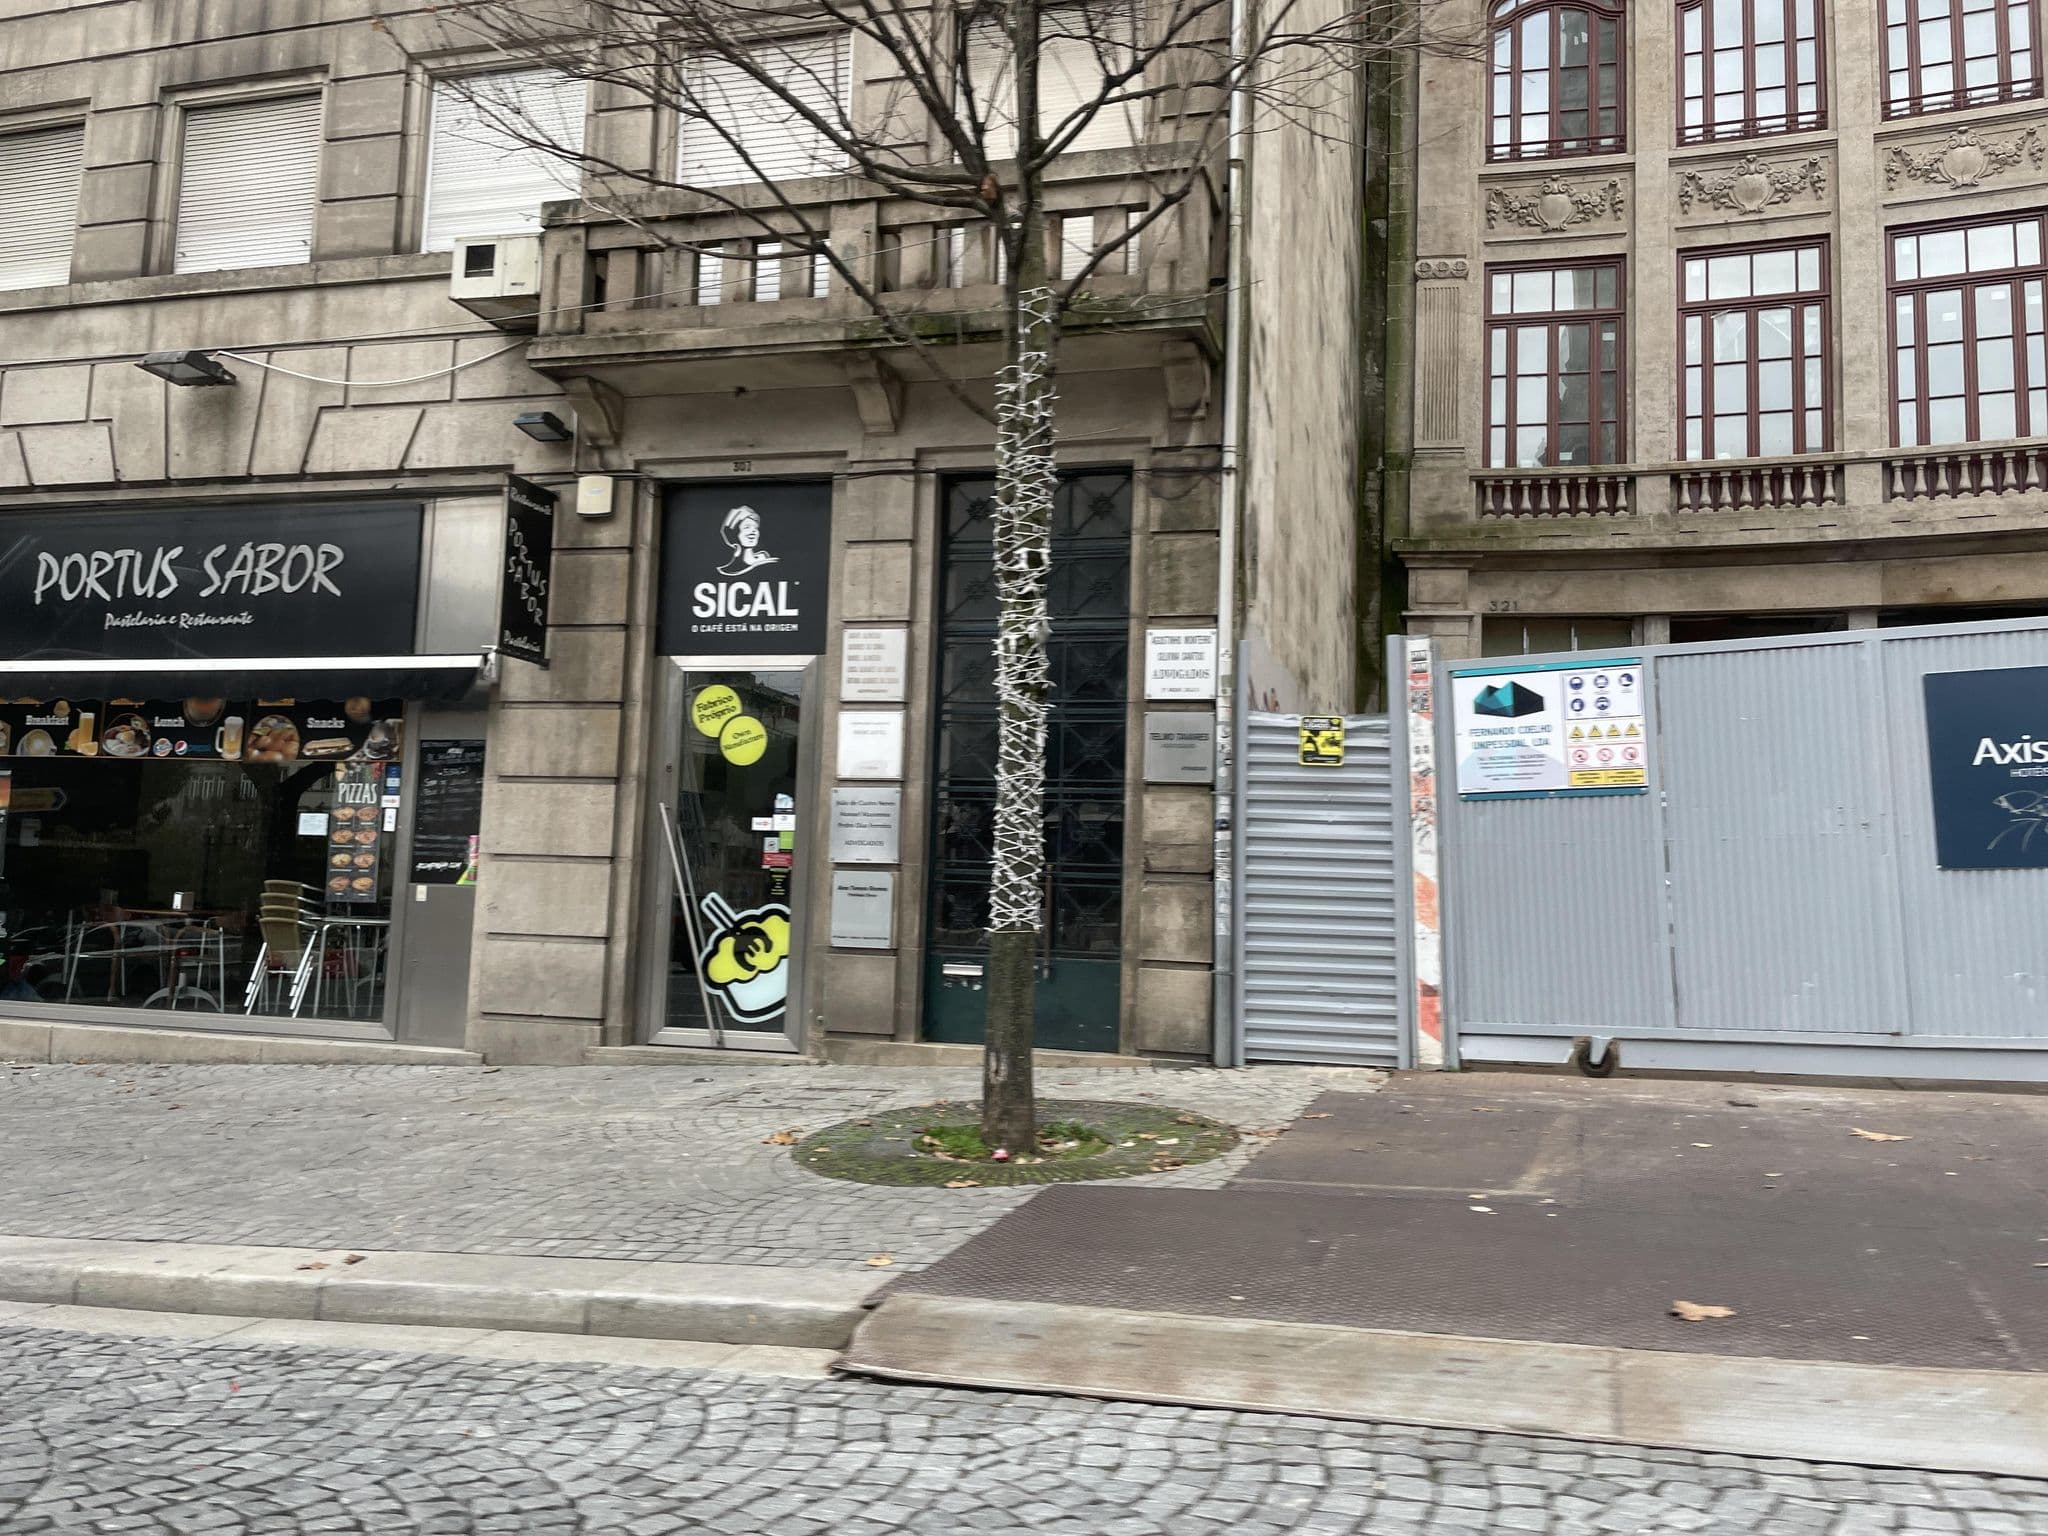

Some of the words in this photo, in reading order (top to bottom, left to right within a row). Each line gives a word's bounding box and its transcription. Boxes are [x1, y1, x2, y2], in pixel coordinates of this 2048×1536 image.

[33, 546, 184, 605] PORTUS
[198, 541, 345, 598] SABOR
[507, 555, 544, 626] SABOR
[692, 581, 799, 618] SICAL
[1489, 600, 1518, 612] 321
[104, 610, 167, 630] Pastelaria
[178, 611, 255, 629] Restaurante
[691, 624, 699, 633] O
[700, 623, 724, 633] CAFÉ
[725, 623, 748, 633] ESTÁ
[749, 624, 763, 632] NA
[764, 623, 799, 632] ORIGEM
[696, 695, 734, 713] Fabrico
[25, 714, 69, 726] Breakfast
[154, 716, 185, 728] Lunch
[306, 717, 345, 729] Snacks
[698, 705, 737, 724] Próprio
[1470, 727, 1516, 737] FERNANDO
[338, 782, 378, 804] PIZZAS
